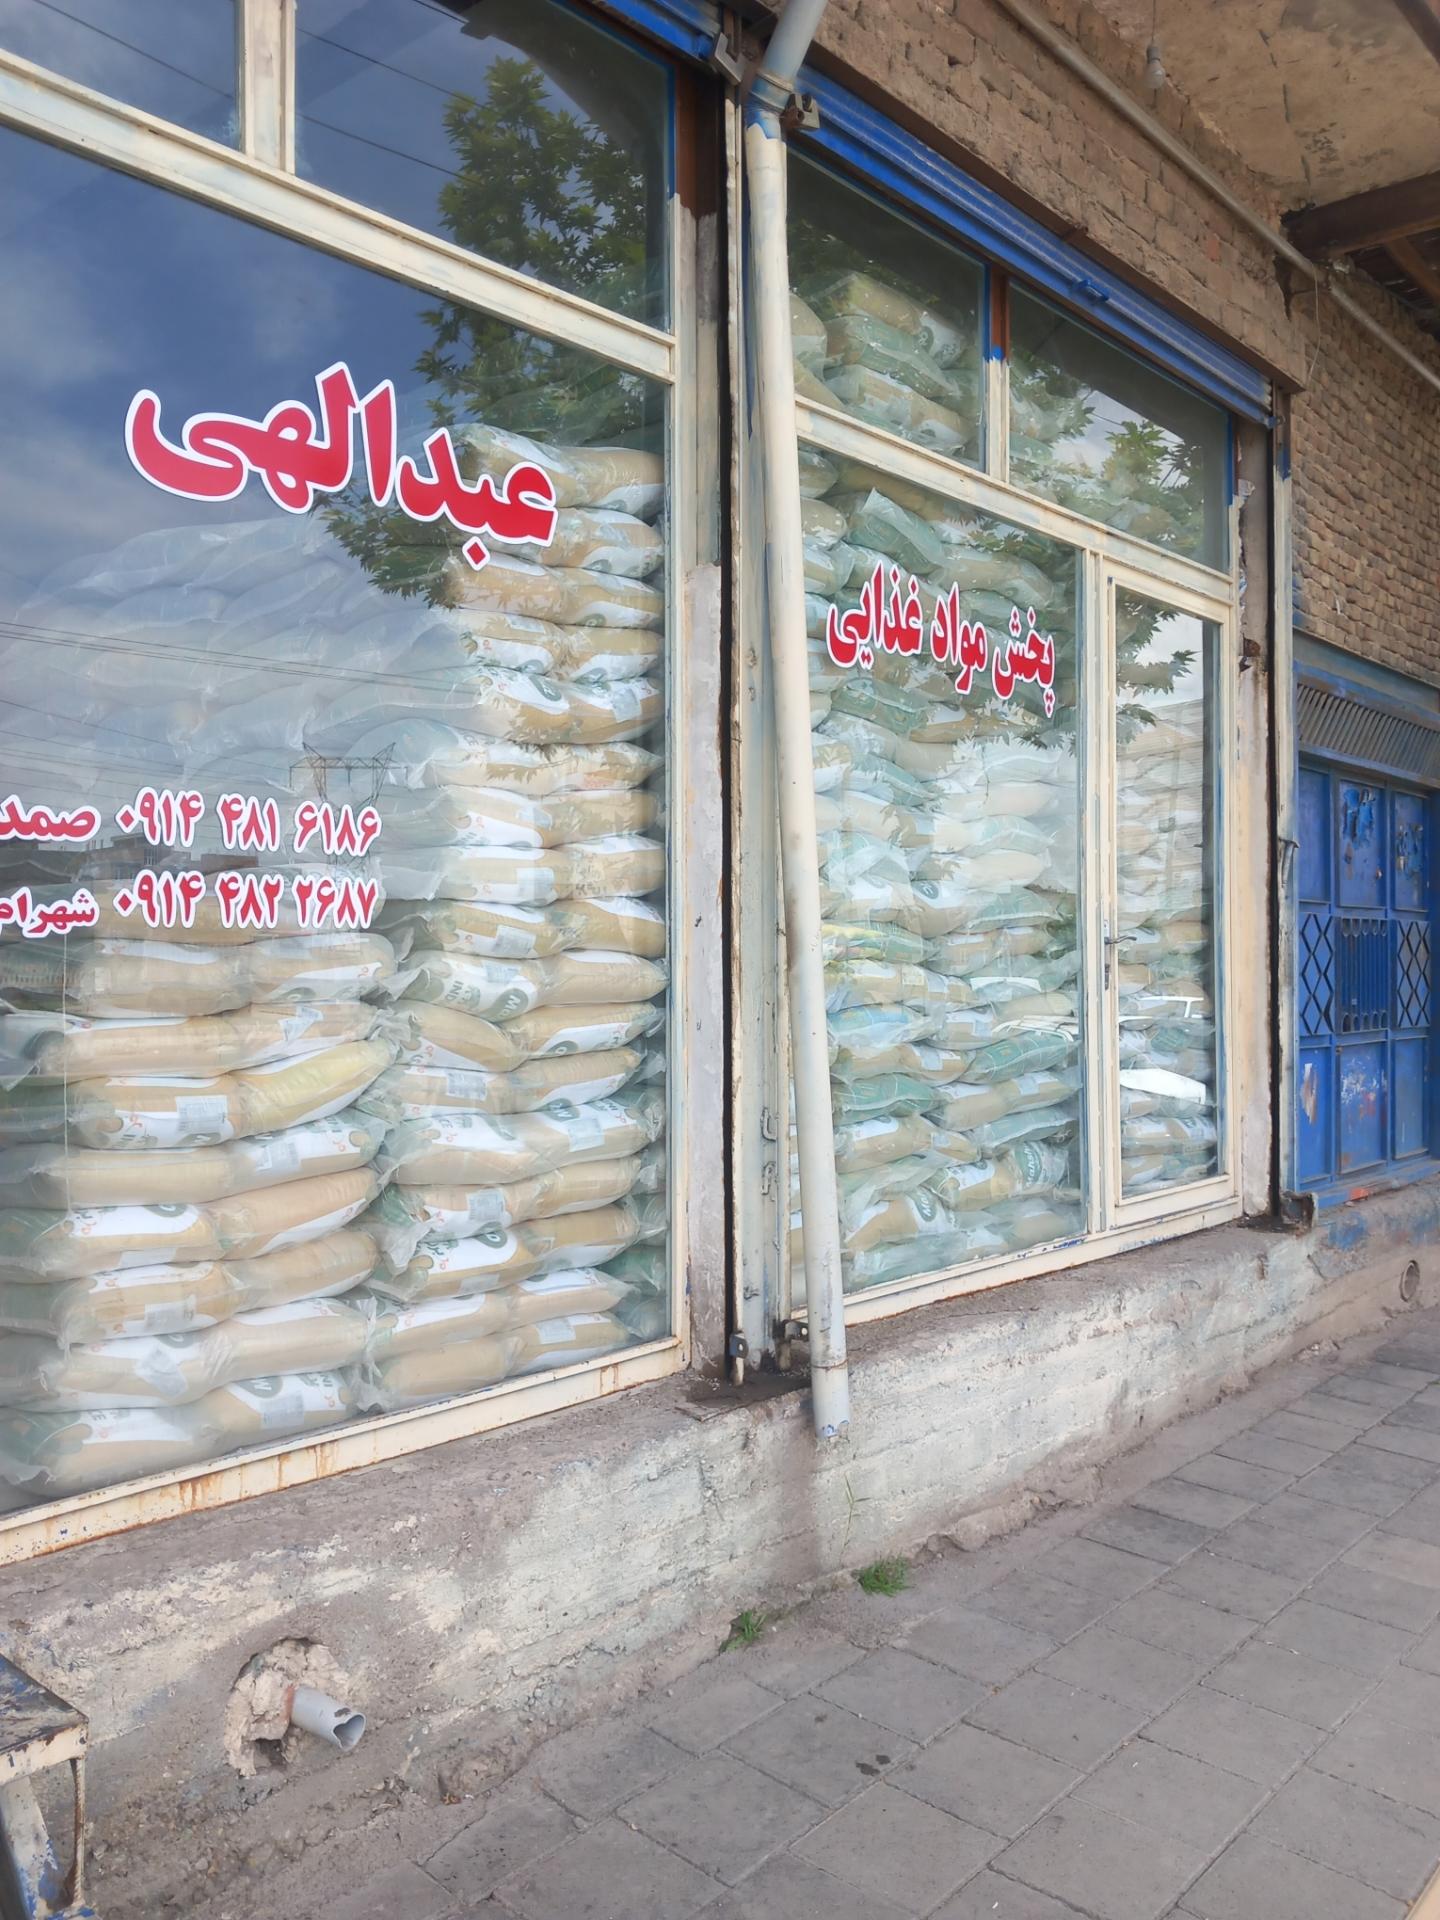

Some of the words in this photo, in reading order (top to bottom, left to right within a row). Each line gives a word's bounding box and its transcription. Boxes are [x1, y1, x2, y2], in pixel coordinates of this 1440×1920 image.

[126, 362, 557, 569] عبدالهی
[827, 561, 923, 669] غذایی
[931, 583, 987, 694] مواد
[993, 607, 1055, 717] پخش
[0, 795, 100, 841] صمد
[118, 787, 204, 847] ۰۹۱۴
[218, 793, 280, 851] ۴۸۱
[294, 800, 381, 856] ۶۱۸۶
[113, 870, 206, 928] ۰۹۱۴
[215, 871, 283, 929] ۴۸۲
[292, 874, 379, 929] ۲۶۸۷
